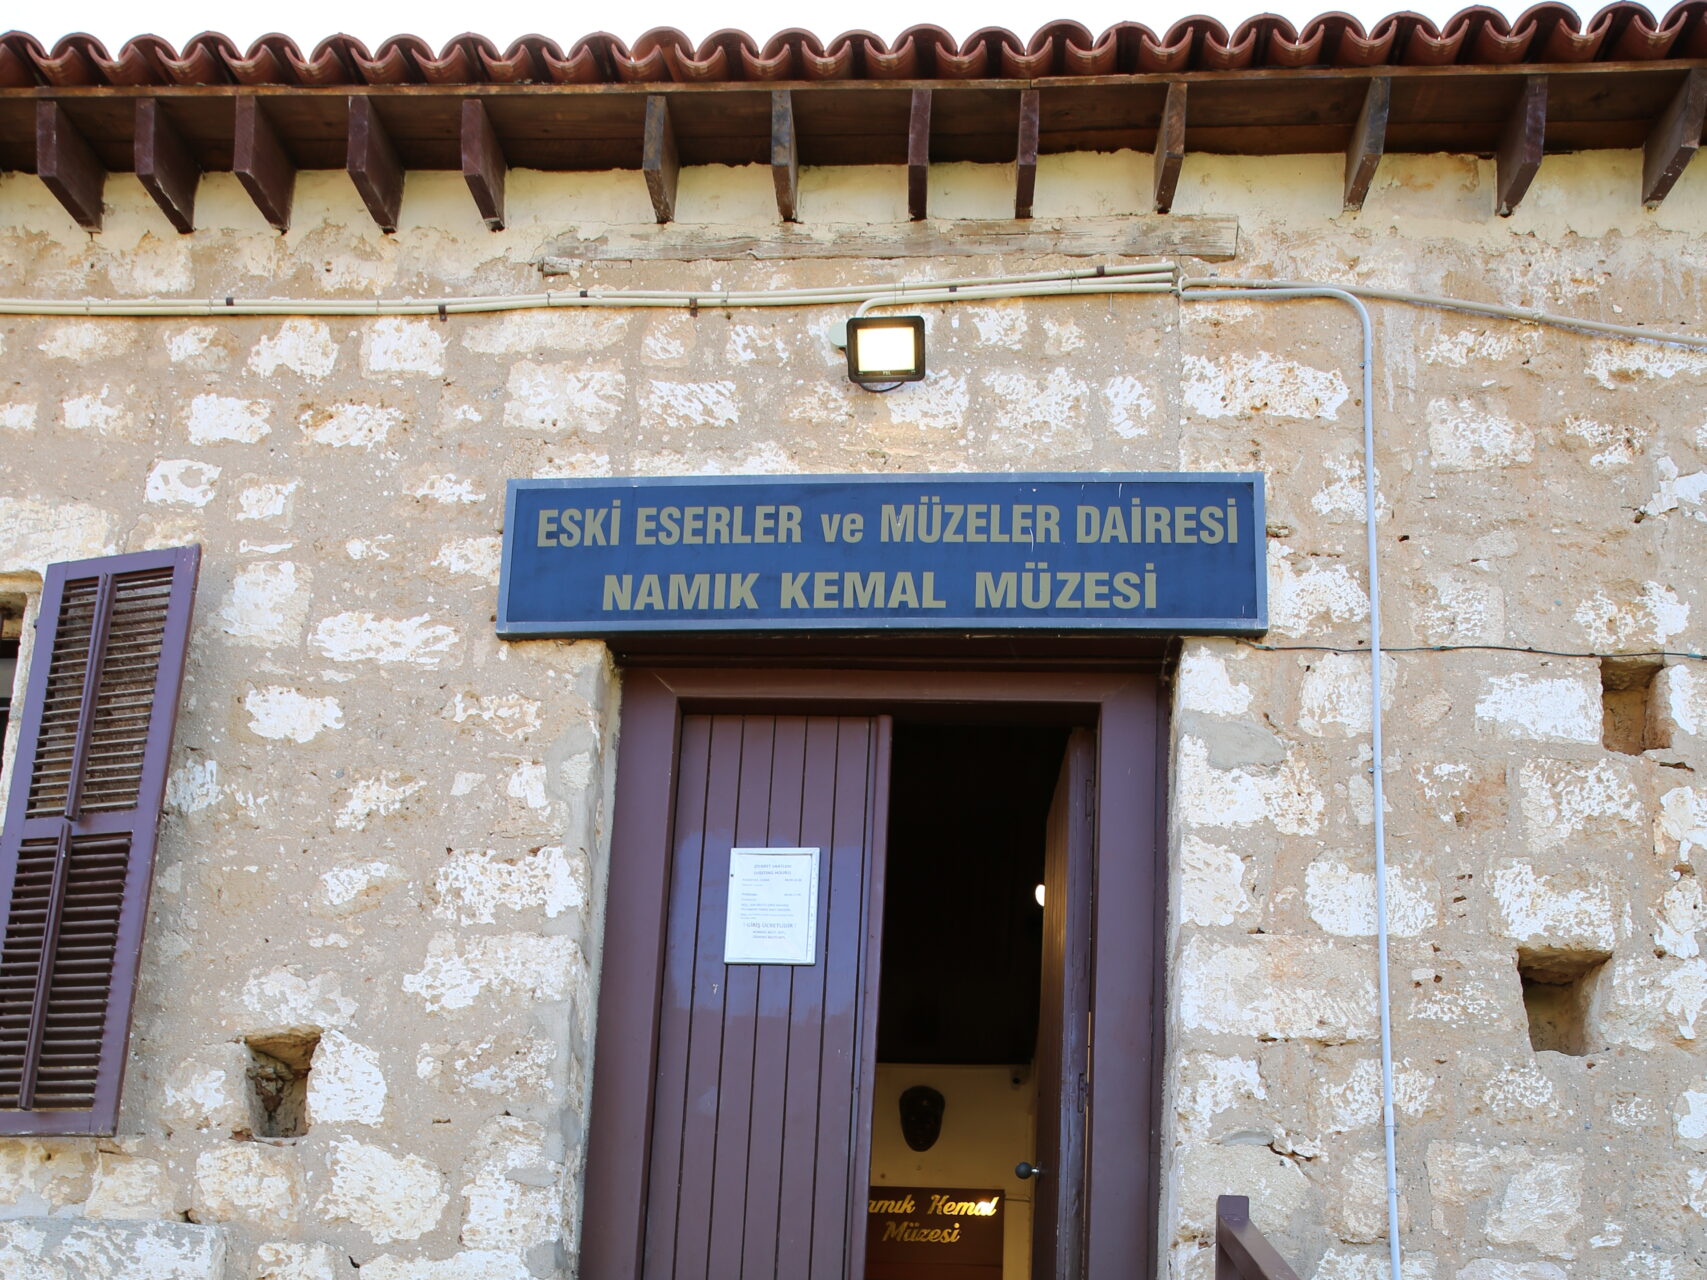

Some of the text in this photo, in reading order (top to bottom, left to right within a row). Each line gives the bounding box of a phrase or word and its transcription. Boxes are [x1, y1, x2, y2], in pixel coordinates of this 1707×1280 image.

[537, 496, 1238, 547] ESKİ ESERLER ve MÜZELER DAİRESİ
[603, 561, 1156, 610] NAMIK KEMAL MÜZESİ
[868, 1195, 999, 1216] amık Kemal
[883, 1221, 961, 1243] Müzesi
